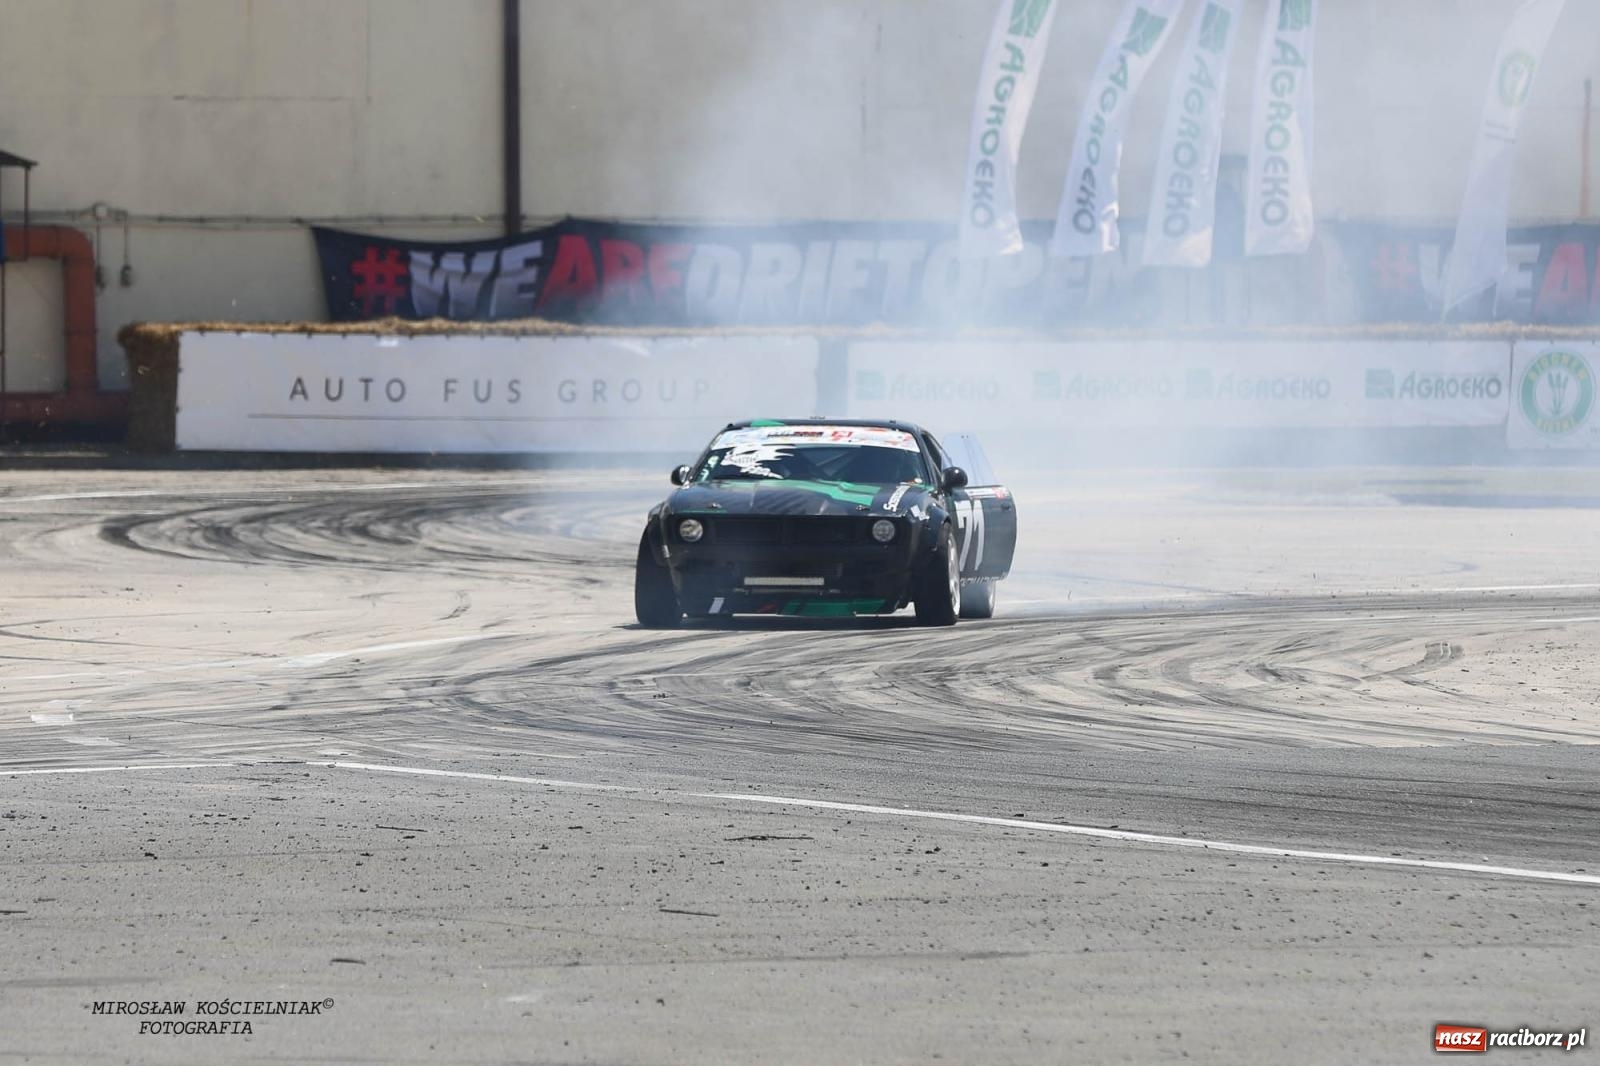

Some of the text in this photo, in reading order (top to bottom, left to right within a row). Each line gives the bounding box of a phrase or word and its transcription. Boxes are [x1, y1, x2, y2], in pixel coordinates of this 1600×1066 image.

[1261, 37, 1308, 227] AGROEKO
[289, 376, 710, 403] AUTO FUS GROUP
[1400, 369, 1502, 399] AGROEKO
